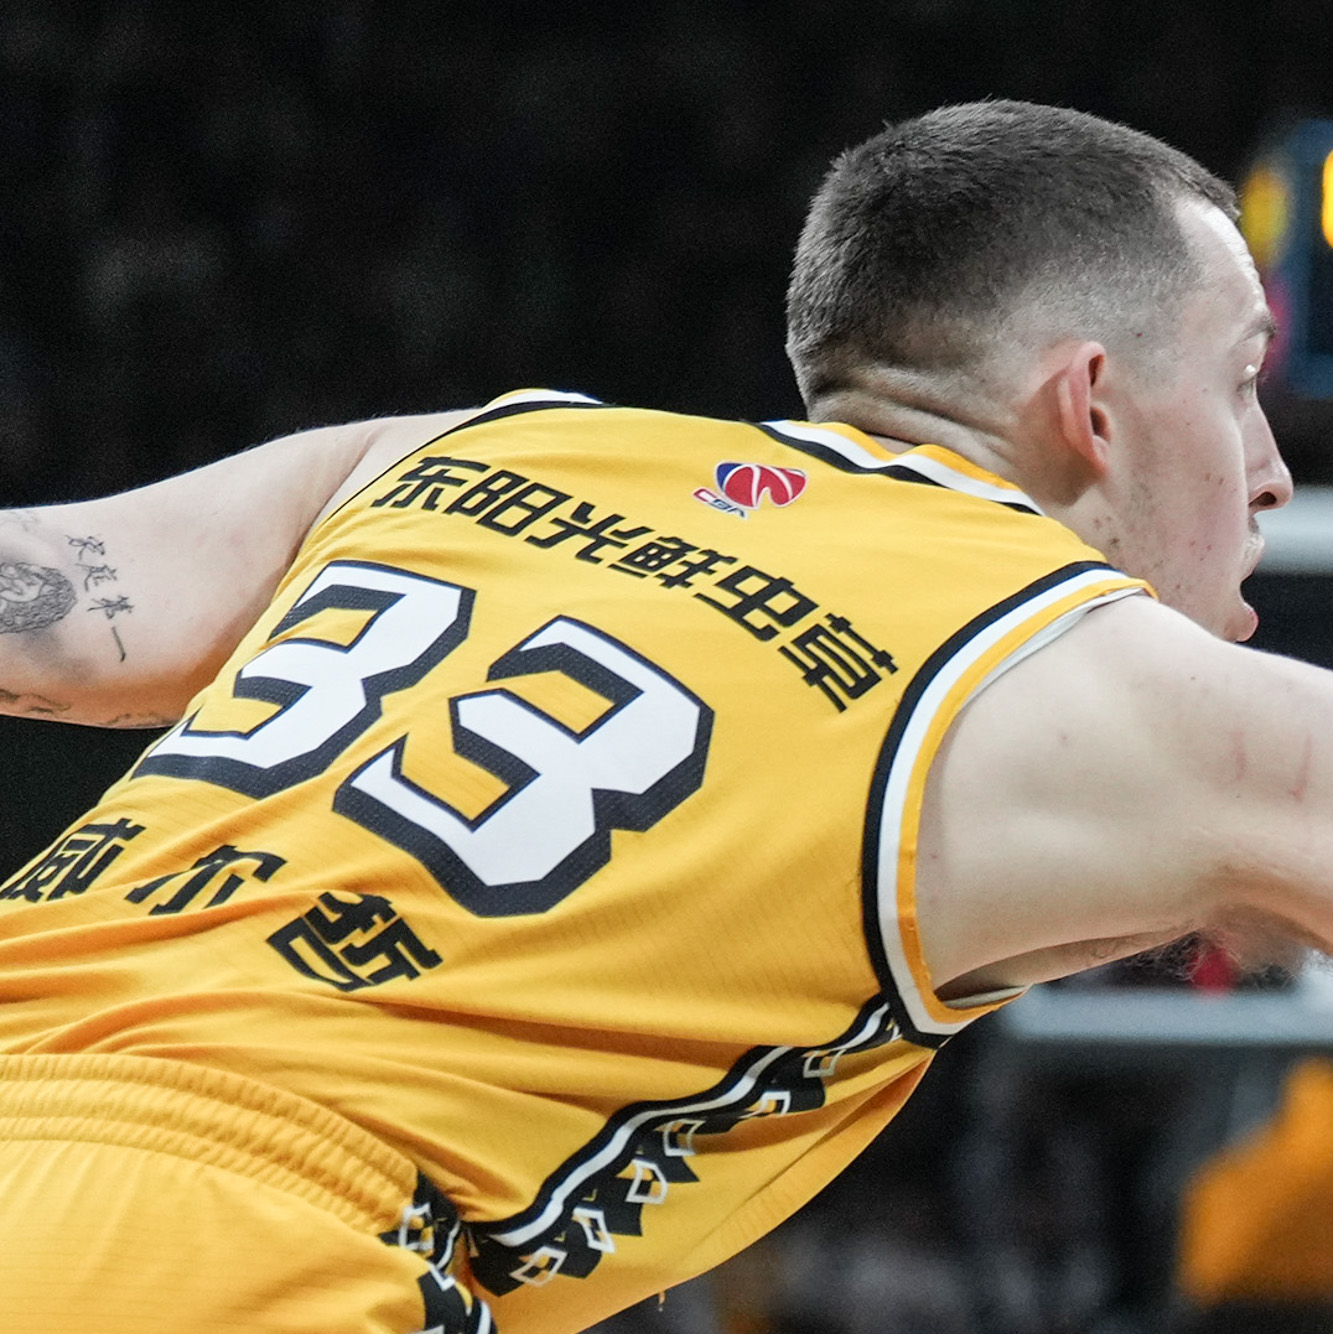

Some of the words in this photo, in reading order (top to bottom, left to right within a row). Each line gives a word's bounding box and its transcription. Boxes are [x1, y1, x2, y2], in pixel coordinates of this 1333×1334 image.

[372, 456, 898, 713] 东阳光鲜虫草
[693, 488, 745, 518] CBA
[128, 558, 716, 918] 33
